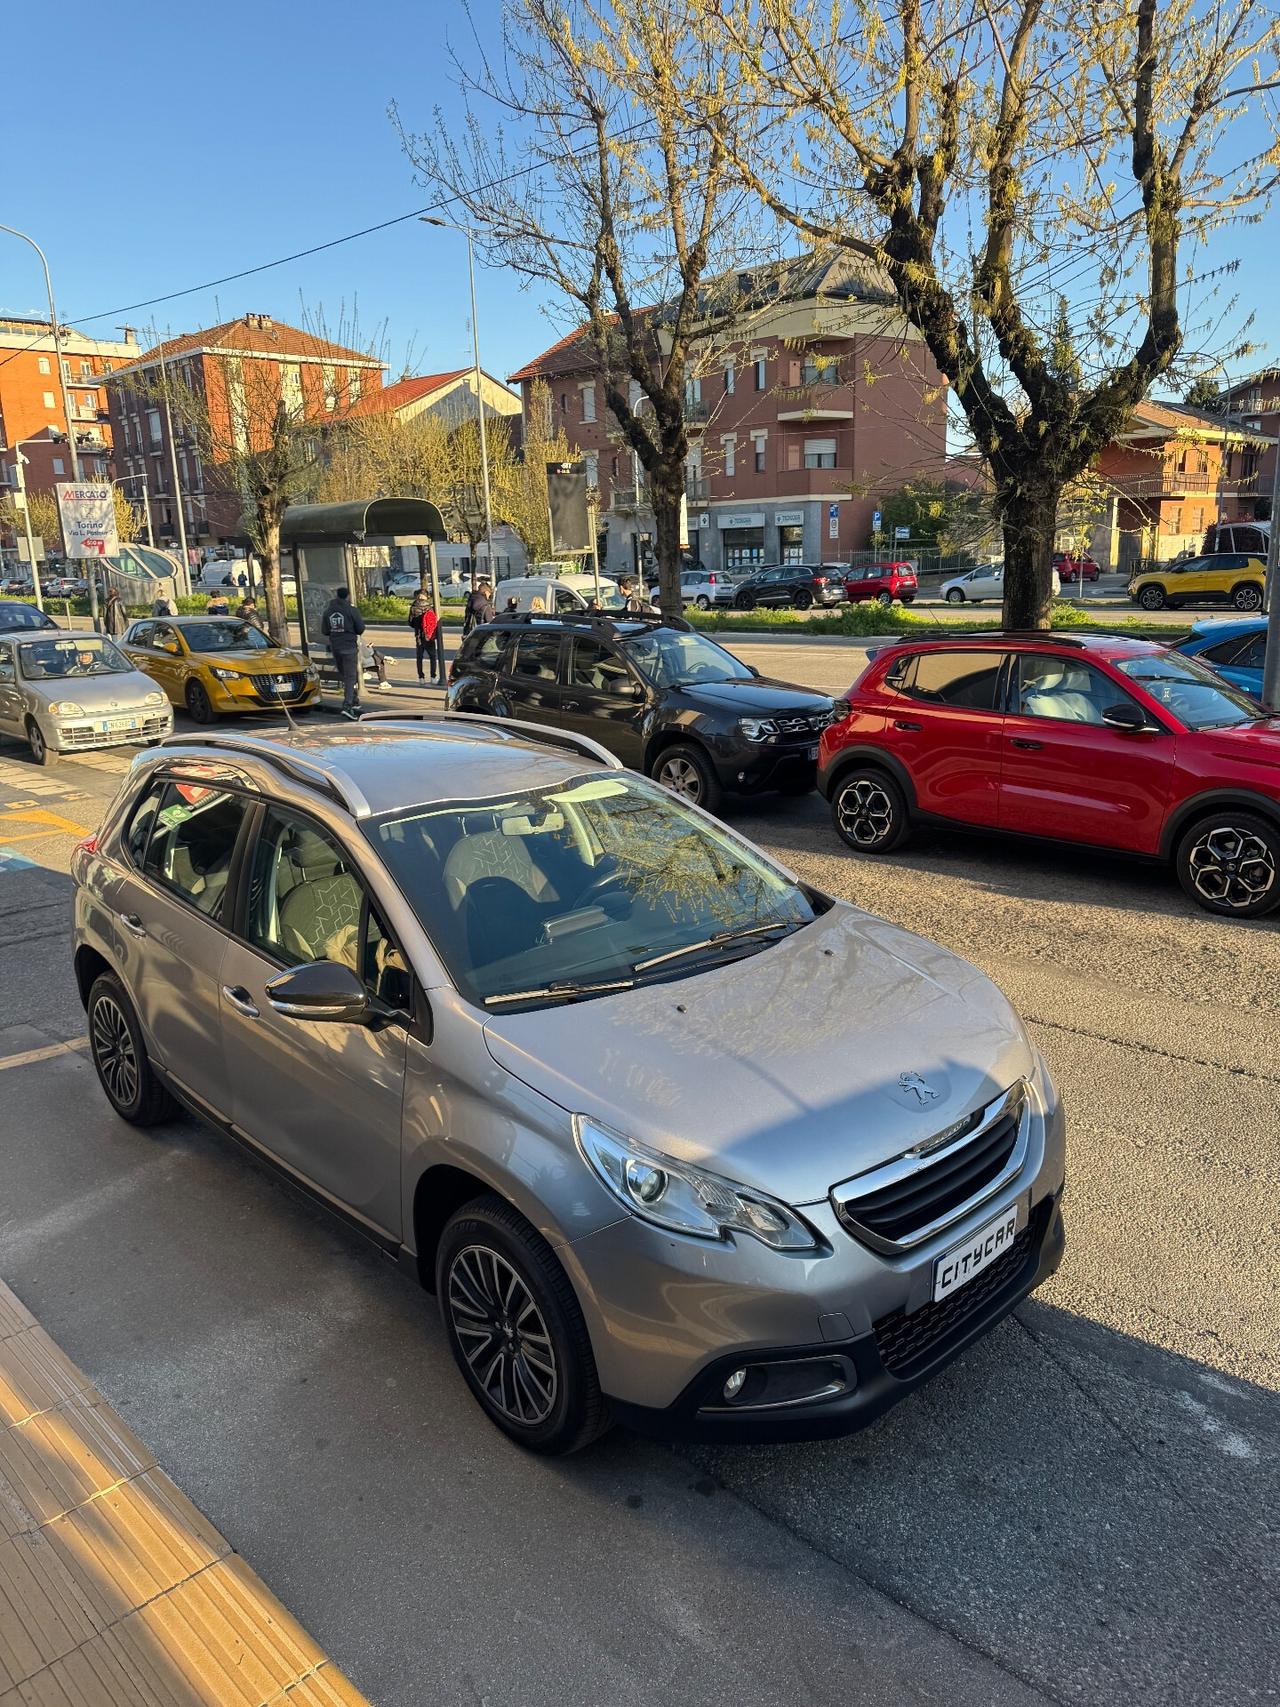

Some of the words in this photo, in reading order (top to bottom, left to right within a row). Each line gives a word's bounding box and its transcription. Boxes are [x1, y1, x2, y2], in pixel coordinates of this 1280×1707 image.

[874, 512, 880, 520] P
[77, 521, 104, 529] Torino
[941, 1217, 1016, 1289] CITYCAR
